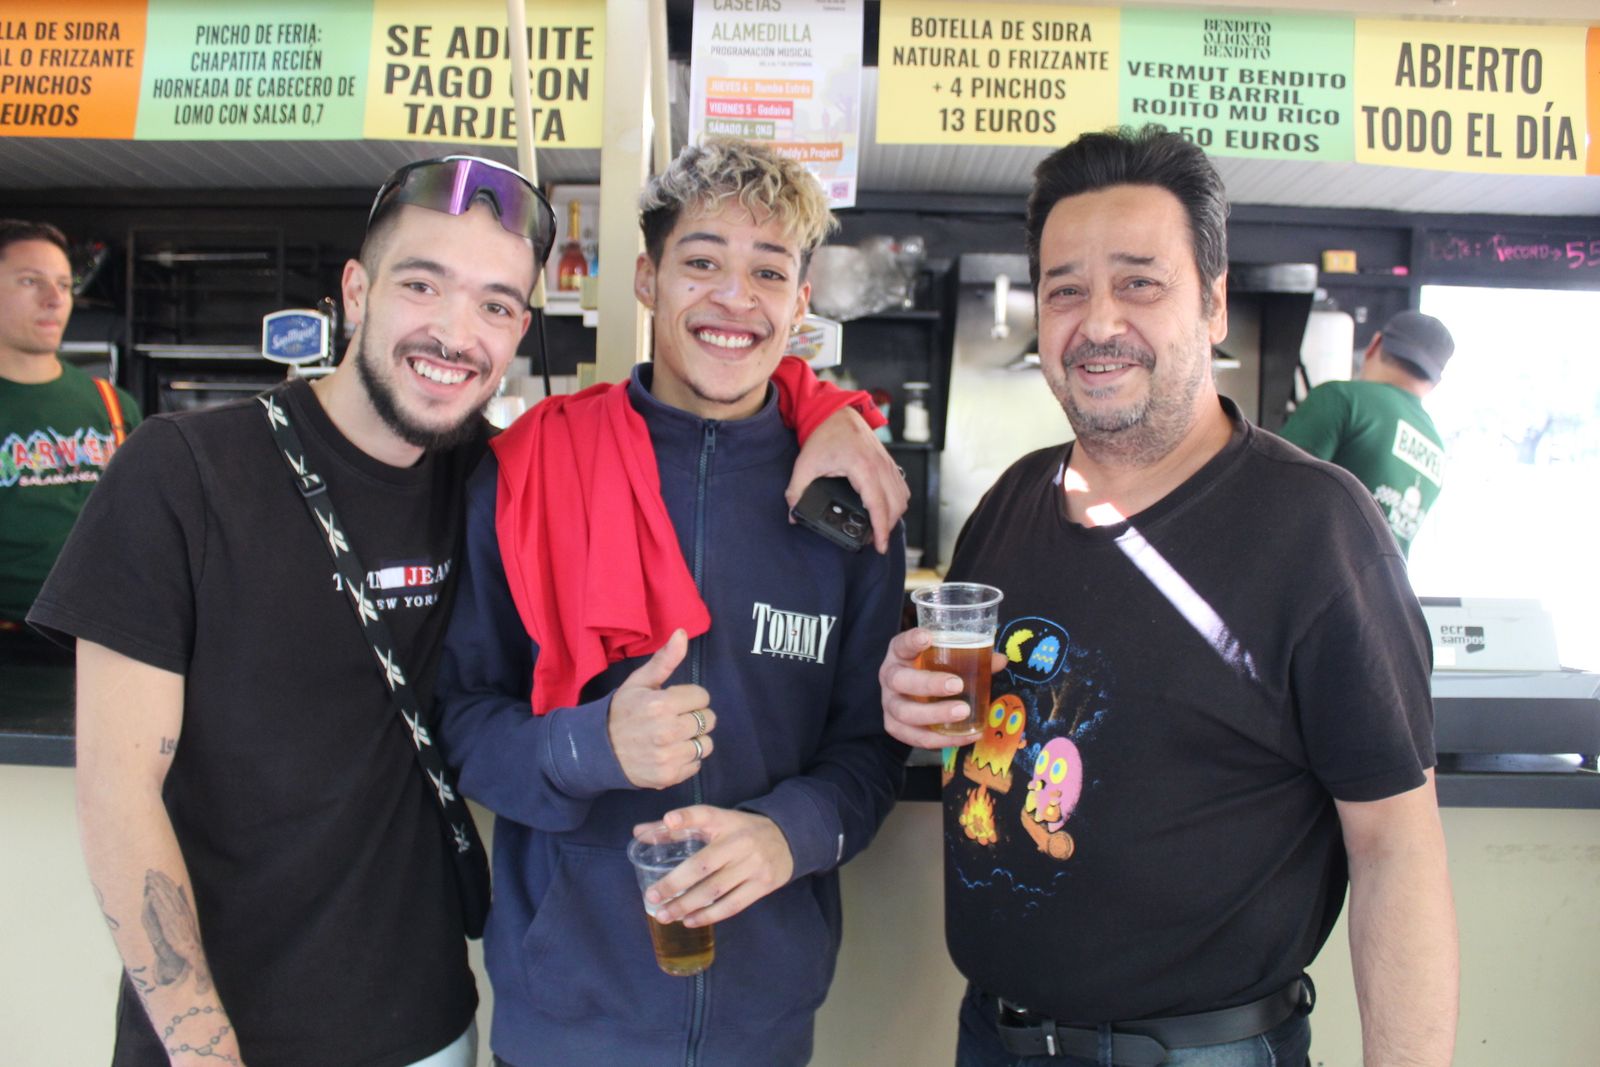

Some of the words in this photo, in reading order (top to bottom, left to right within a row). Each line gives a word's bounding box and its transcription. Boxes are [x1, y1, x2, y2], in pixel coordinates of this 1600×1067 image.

[35, 22, 58, 40] DE
[64, 22, 120, 41] SIDRA
[196, 25, 251, 45] PINCHO
[256, 25, 273, 44] DE
[277, 24, 322, 43] FERIA:
[712, 22, 811, 42] ALAMEDILLA
[911, 17, 993, 40] BOTELLA
[1001, 20, 1025, 41] DE
[1032, 21, 1092, 42] SIDRA
[1204, 18, 1271, 33] BENDITO
[386, 24, 432, 57] SE
[20, 49, 32, 67] O
[40, 49, 134, 68] FRIZZANTE
[191, 51, 266, 72] CHAPATITA
[272, 46, 322, 70] RECIÉN
[777, 47, 813, 58] MUSICAL
[892, 46, 980, 68] NATURAL
[988, 49, 1000, 68] O
[1008, 50, 1109, 70] FRIZZANTE
[1203, 45, 1271, 60] BENDITO
[1127, 61, 1229, 82] VERMUT
[1239, 68, 1346, 89] BENDITO
[1395, 42, 1543, 94] ABIERTO
[1, 75, 92, 95] PINCHOS
[153, 78, 229, 98] HORNEADA
[235, 78, 252, 97] DE
[257, 77, 332, 97] CABECERO
[338, 76, 356, 96] DE
[384, 63, 492, 99] PAGO
[950, 77, 962, 98] 4
[971, 78, 1066, 99] PINCHOS
[1170, 82, 1199, 99] DE
[1210, 85, 1304, 105] BARRIL
[0, 104, 79, 126] EUROS
[174, 105, 213, 125] LOMO
[218, 104, 248, 125] CON
[252, 104, 297, 124] SALSA
[302, 104, 324, 126] 0,7
[709, 102, 744, 114] VIERNES
[745, 104, 752, 114] 5
[1133, 98, 1219, 119] ROJITO
[1230, 105, 1267, 121] MU
[1278, 107, 1340, 126] RICO
[939, 108, 964, 131] 13
[975, 109, 1056, 133] EUROS
[1362, 105, 1452, 155] TODO
[1467, 112, 1502, 158] EL
[1516, 101, 1577, 160] DÍA
[1226, 129, 1320, 153] EUROS
[810, 146, 839, 160] Project
[750, 602, 837, 664] TOMMY
[1440, 626, 1463, 635] ecr
